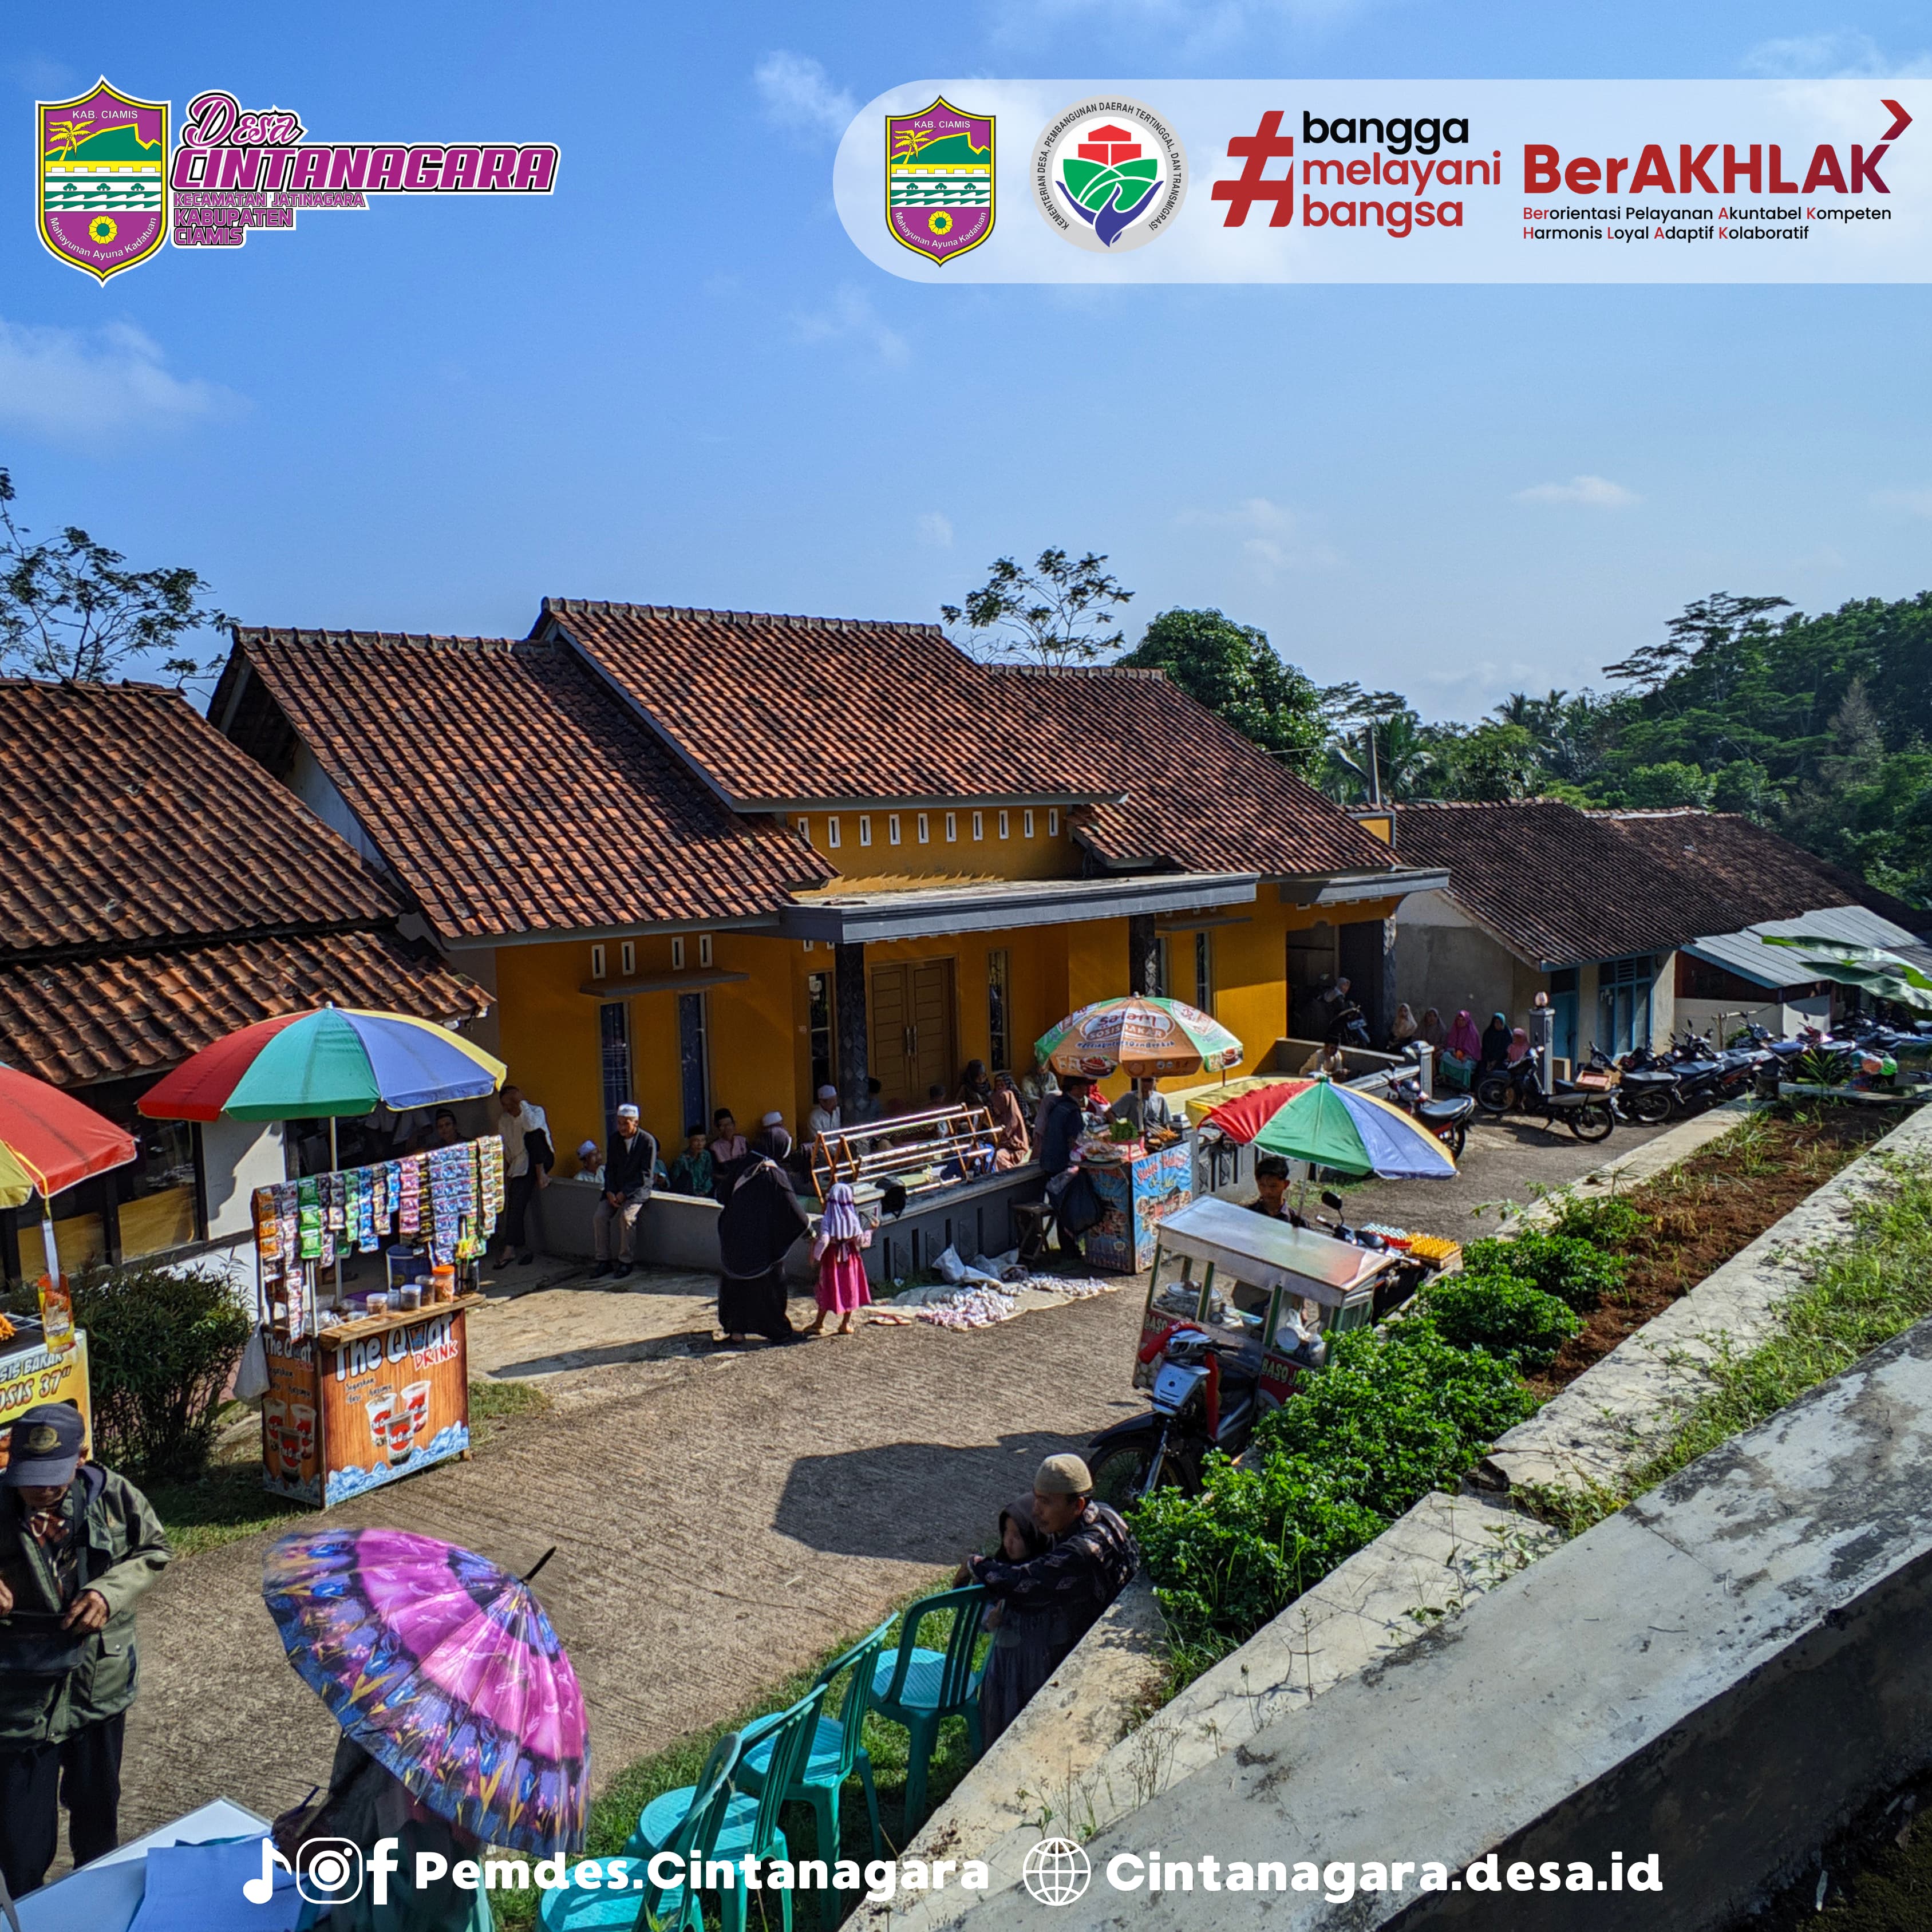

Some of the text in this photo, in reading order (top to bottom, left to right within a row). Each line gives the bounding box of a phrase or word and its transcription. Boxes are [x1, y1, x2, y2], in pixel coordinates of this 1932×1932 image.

[1089, 1025, 1121, 1039] SOSIS
[263, 1332, 283, 1357] The
[414, 1339, 459, 1372] DRINK
[331, 1336, 382, 1382] The
[1261, 1357, 1289, 1384] BASO
